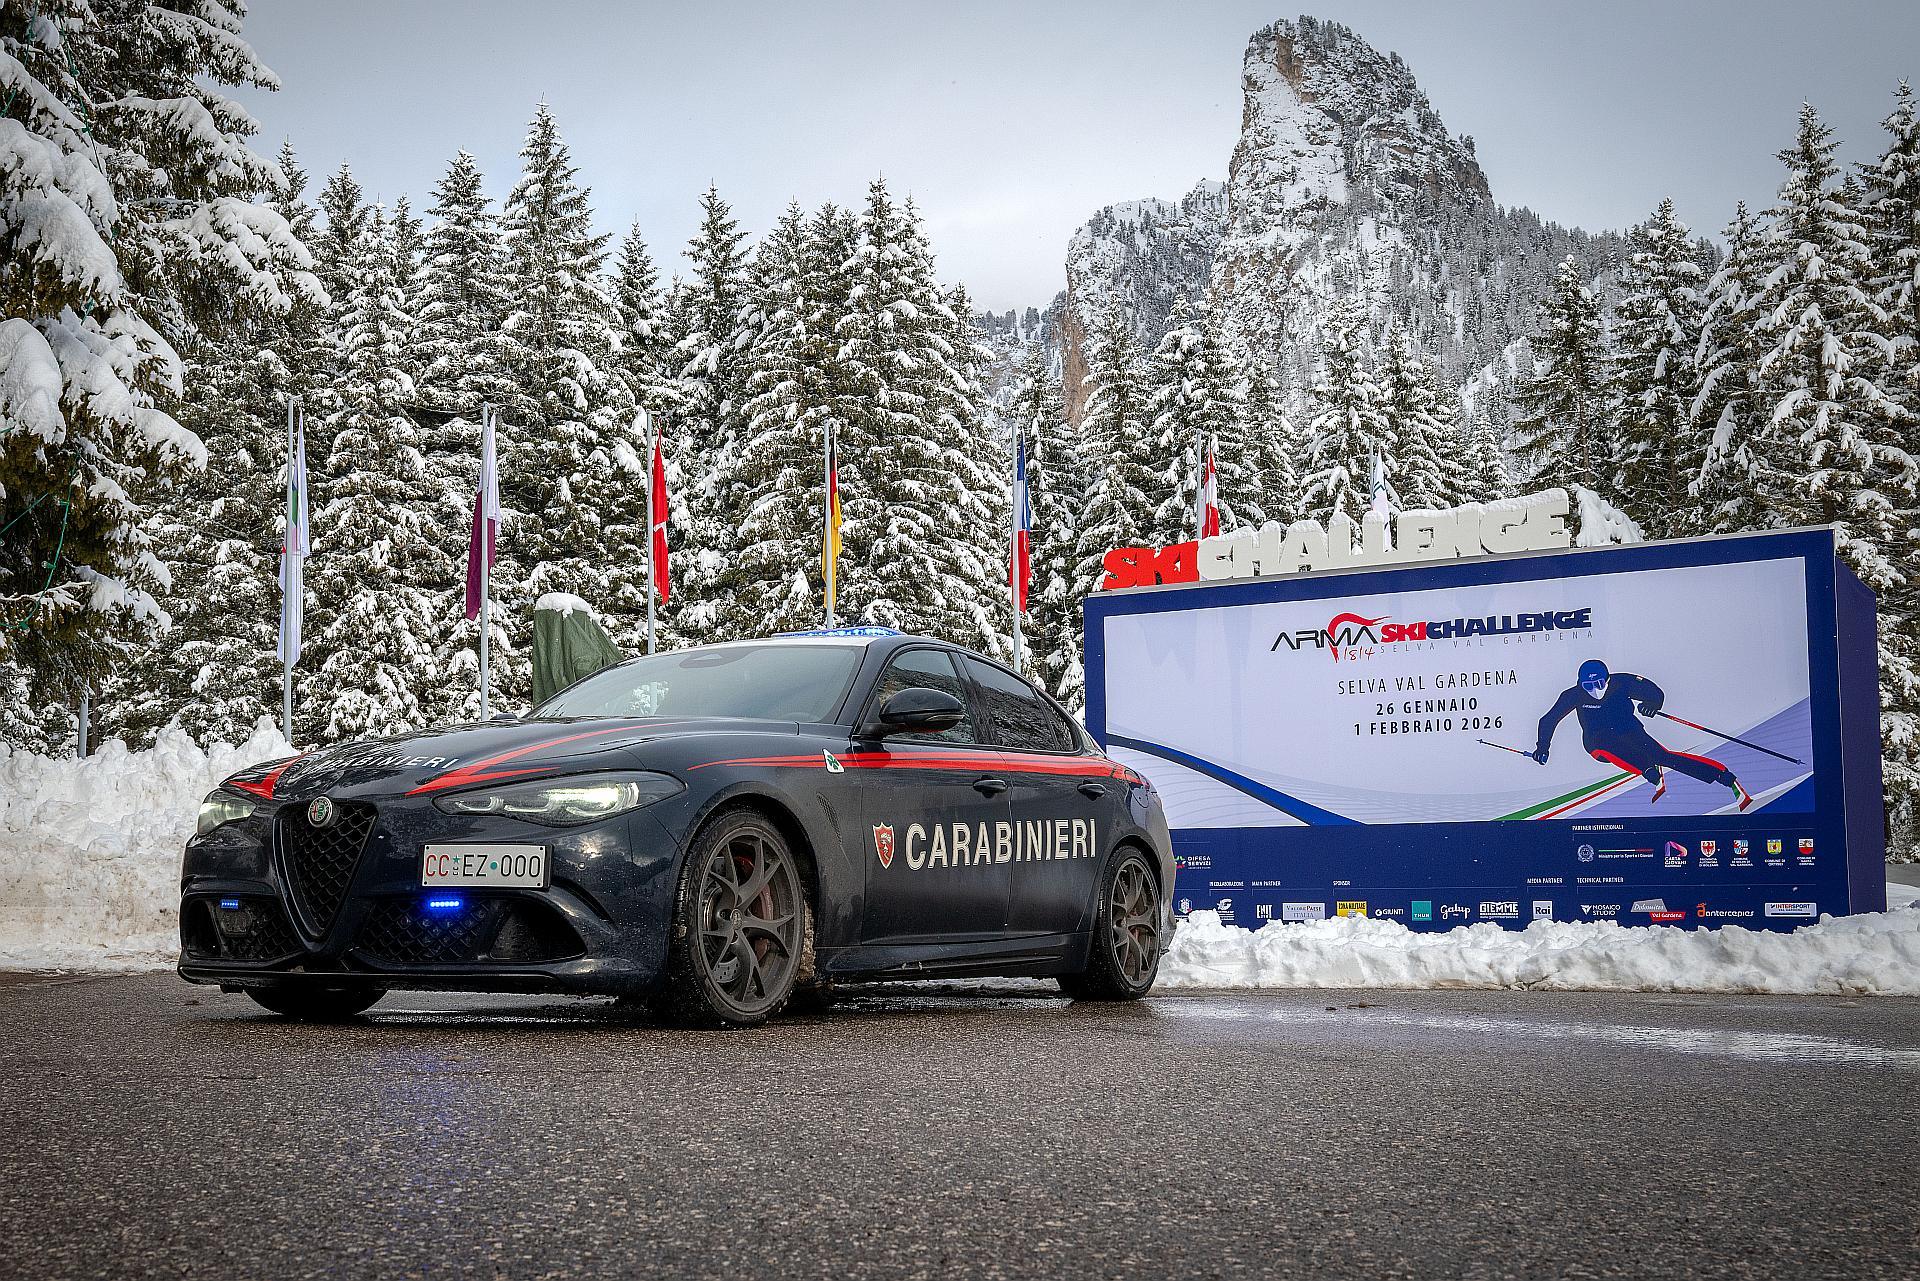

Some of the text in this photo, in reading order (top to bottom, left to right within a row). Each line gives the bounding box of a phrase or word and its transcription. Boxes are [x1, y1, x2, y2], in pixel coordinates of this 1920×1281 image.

[1271, 625, 1378, 651] ARMA
[1380, 630, 1592, 654] SELVA VAL GARDENA
[1344, 646, 1374, 660] 1814
[1337, 669, 1518, 695] SELVA VAL GARDENA
[1376, 697, 1478, 716] 26 GENNAIO
[1354, 715, 1503, 736] 1 FEBBRAIO 2026
[904, 818, 1096, 871] CARABINIERI
[425, 854, 541, 878] CC EZ 000
[1440, 903, 1471, 919] Galup
[1479, 903, 1519, 913] GIEMME
[1535, 906, 1551, 915] Rai
